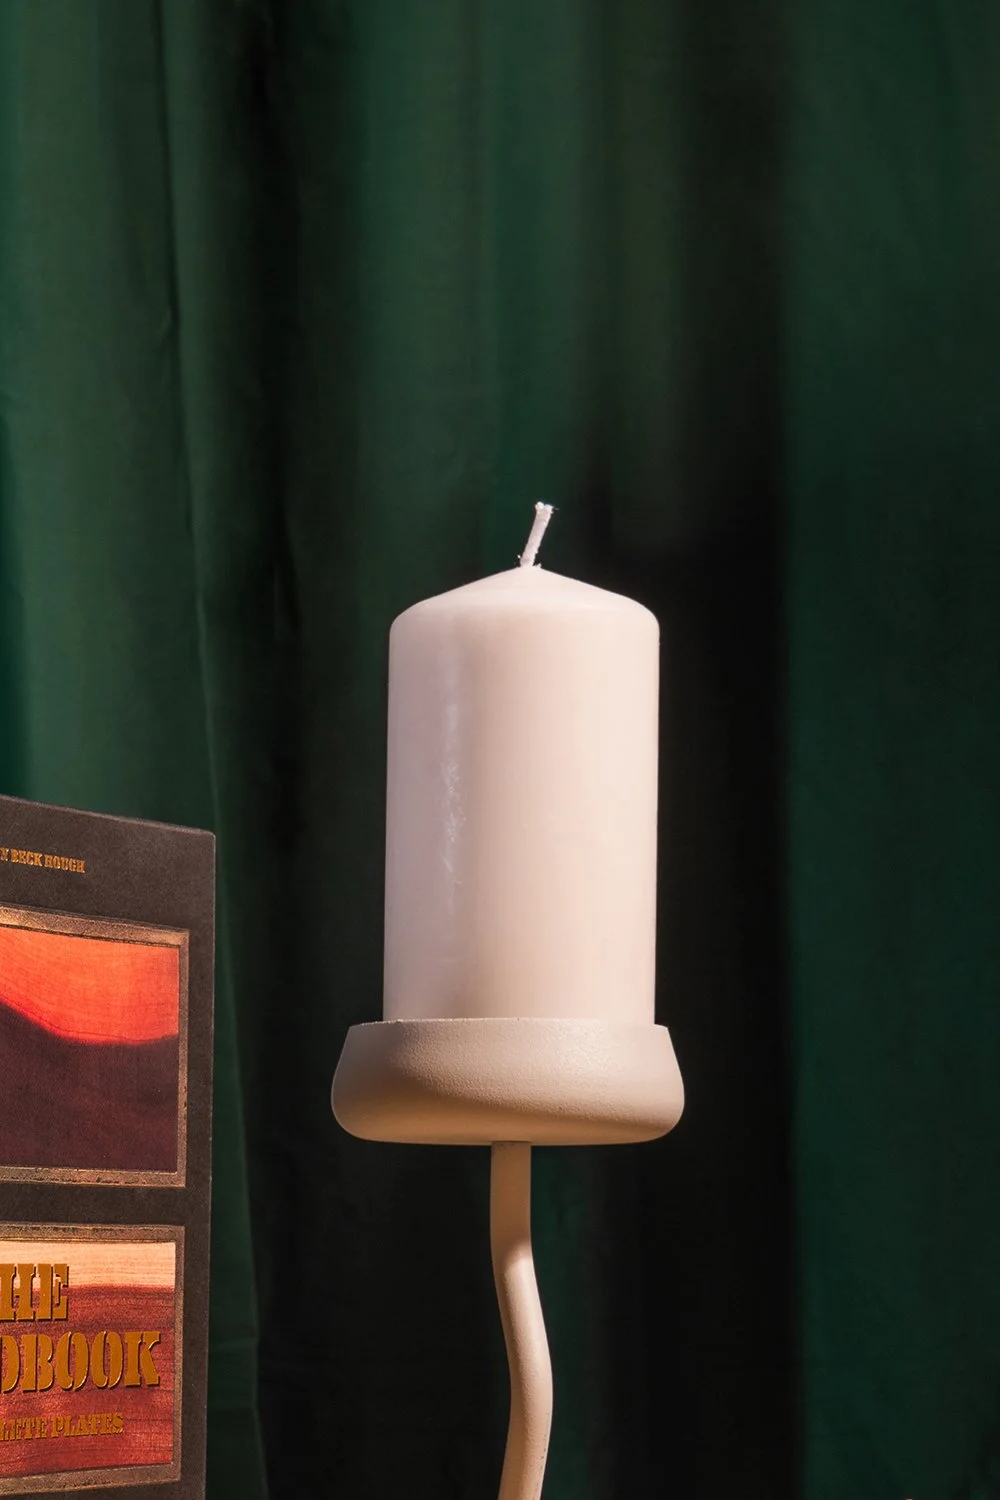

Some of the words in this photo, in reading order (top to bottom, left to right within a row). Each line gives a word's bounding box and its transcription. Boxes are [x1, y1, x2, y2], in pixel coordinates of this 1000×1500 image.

[11, 848, 43, 867] BECK
[44, 854, 86, 873] HOUGH
[51, 1412, 124, 1438] PLATES
